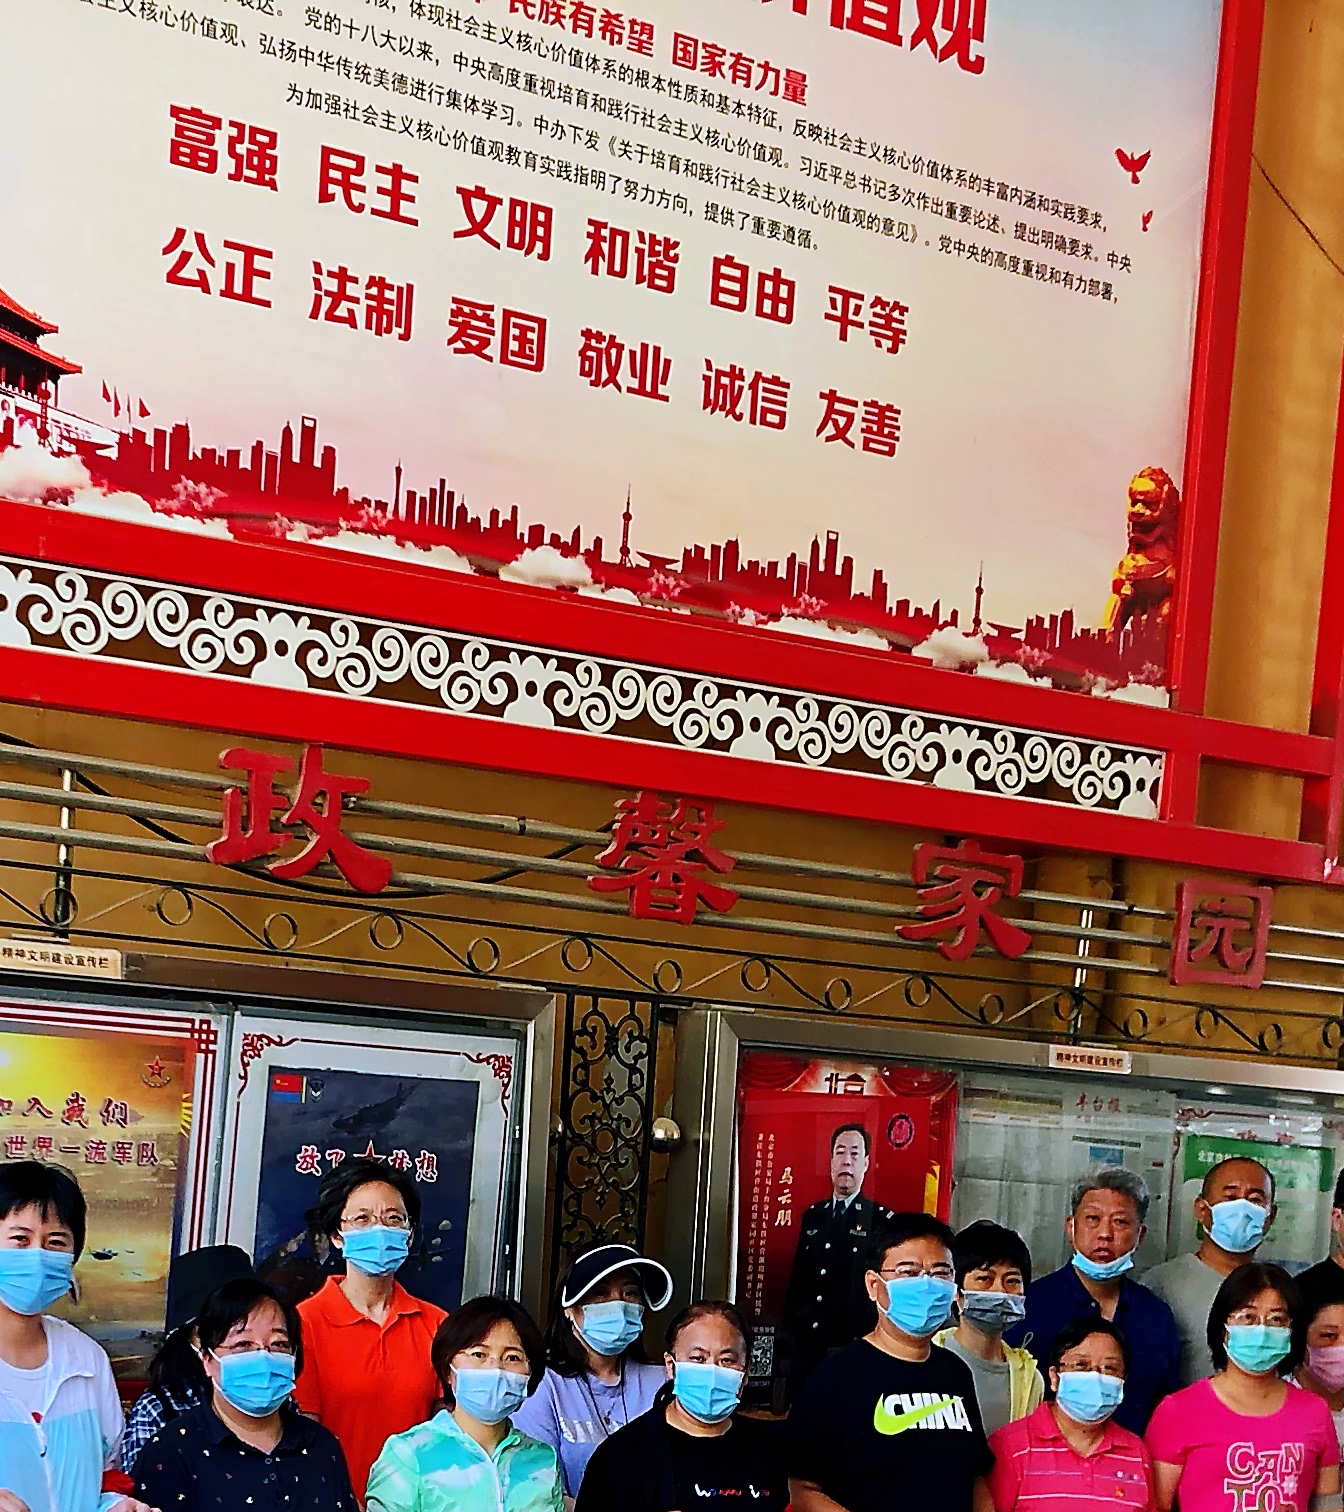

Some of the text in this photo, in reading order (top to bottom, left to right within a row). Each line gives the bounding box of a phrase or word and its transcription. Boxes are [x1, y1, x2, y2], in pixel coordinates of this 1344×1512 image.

[671, 32, 808, 106] 国家有力量
[169, 103, 910, 355] 富强 民主 文明 和谐 自由 平等
[162, 225, 902, 457] 公正 法制 爱国 敬业 诚信 友善
[886, 1394, 972, 1432] CHINA
[1227, 1442, 1304, 1484] CAN
